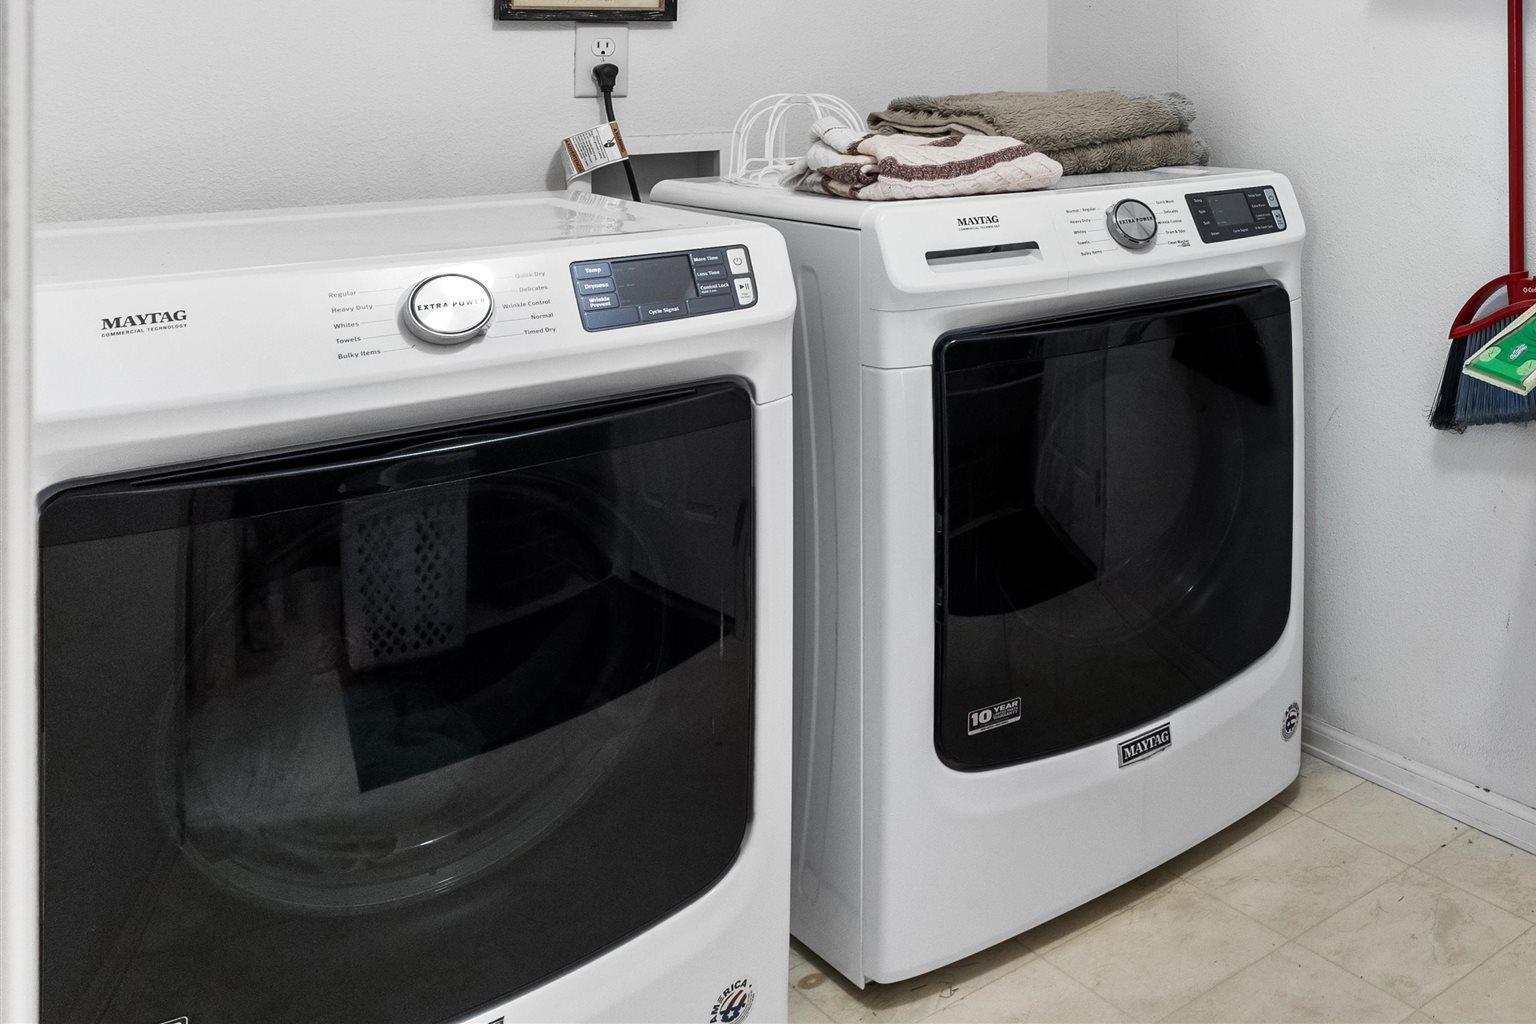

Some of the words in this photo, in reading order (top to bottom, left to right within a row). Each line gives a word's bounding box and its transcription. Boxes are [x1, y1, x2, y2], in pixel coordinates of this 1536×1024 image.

[957, 215, 999, 226] MAYTAG
[519, 285, 548, 293] Delicates
[584, 282, 609, 290] Dryness
[328, 290, 357, 298] Regular
[417, 302, 448, 311] EXTRA
[528, 299, 551, 307] Control
[331, 305, 354, 313] Heavy
[101, 309, 187, 330] MAYTAG
[530, 312, 554, 320] Normal
[333, 321, 360, 329] Whites
[101, 328, 145, 338] COMMERCIAL
[147, 323, 188, 332] TECHNOLOGY
[336, 336, 362, 344] Towels
[337, 352, 359, 360] Bulky
[993, 700, 1018, 713] YEAR
[971, 709, 992, 726] 10
[1123, 730, 1169, 760] MAYTAG
[710, 978, 748, 1024] AMERICA
